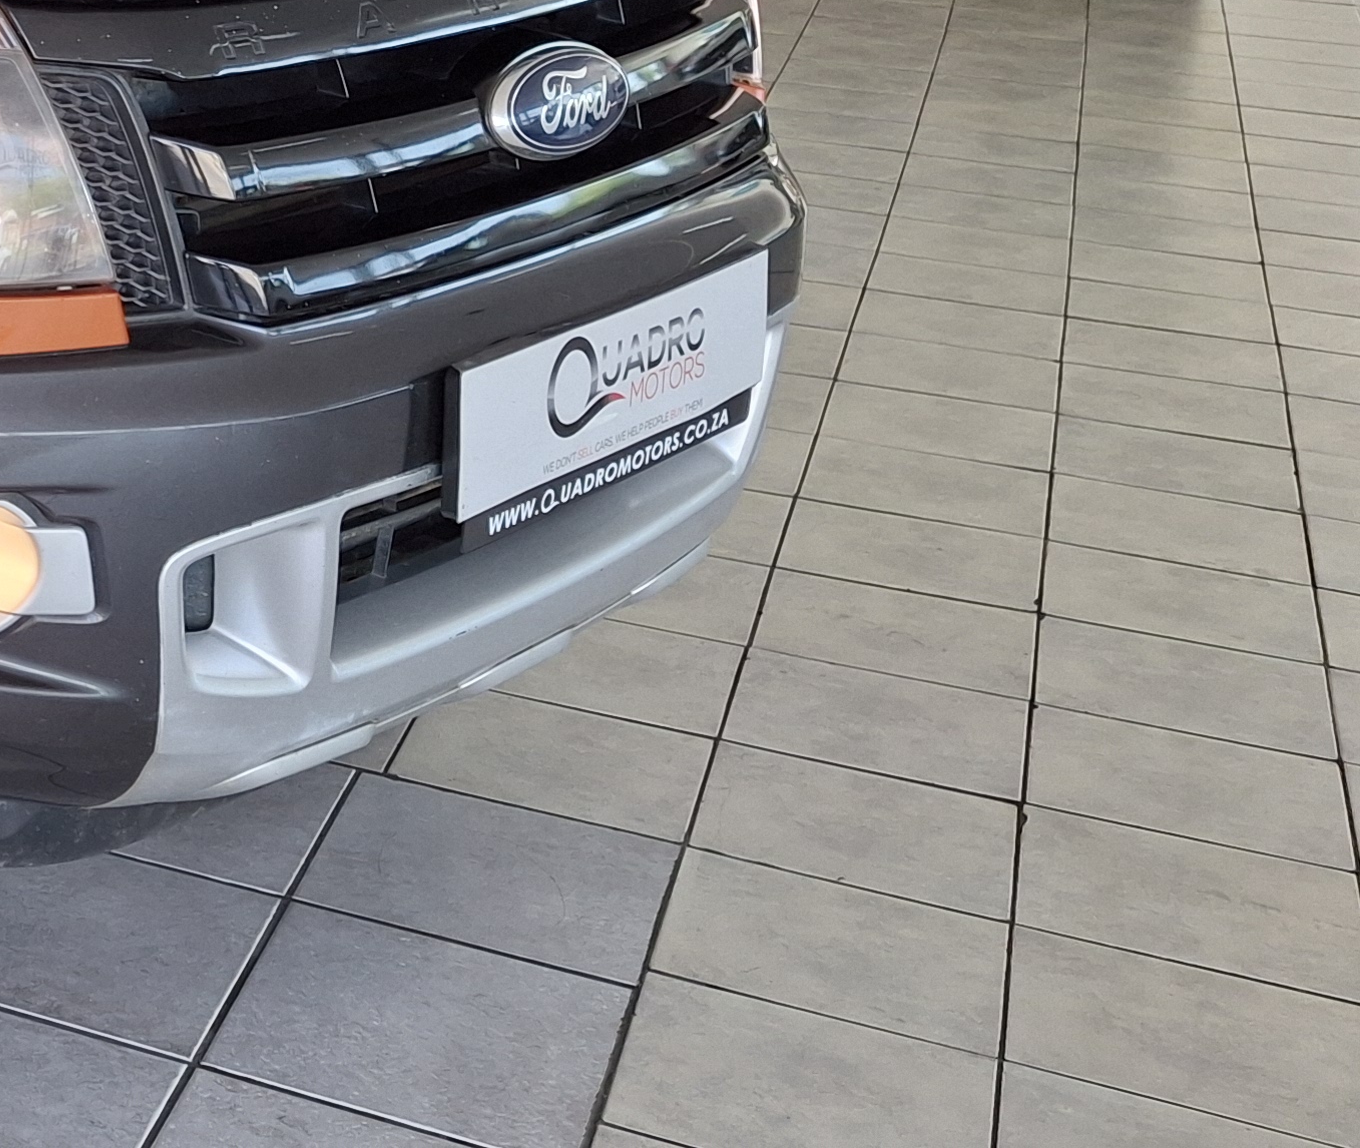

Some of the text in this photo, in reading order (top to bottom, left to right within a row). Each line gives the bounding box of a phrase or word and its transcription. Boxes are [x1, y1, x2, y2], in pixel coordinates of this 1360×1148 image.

[540, 65, 618, 136] Ford
[546, 307, 706, 439] QUADRO
[628, 351, 706, 407] MOTORS
[488, 408, 730, 537] WWW.QUADROMOTORS.CO.ZA
[542, 460, 555, 475] WE
[578, 446, 594, 460] SELL
[615, 430, 627, 444] WE
[627, 424, 644, 438] HELP
[644, 412, 670, 432] PEOPLE
[670, 407, 684, 420] BUY
